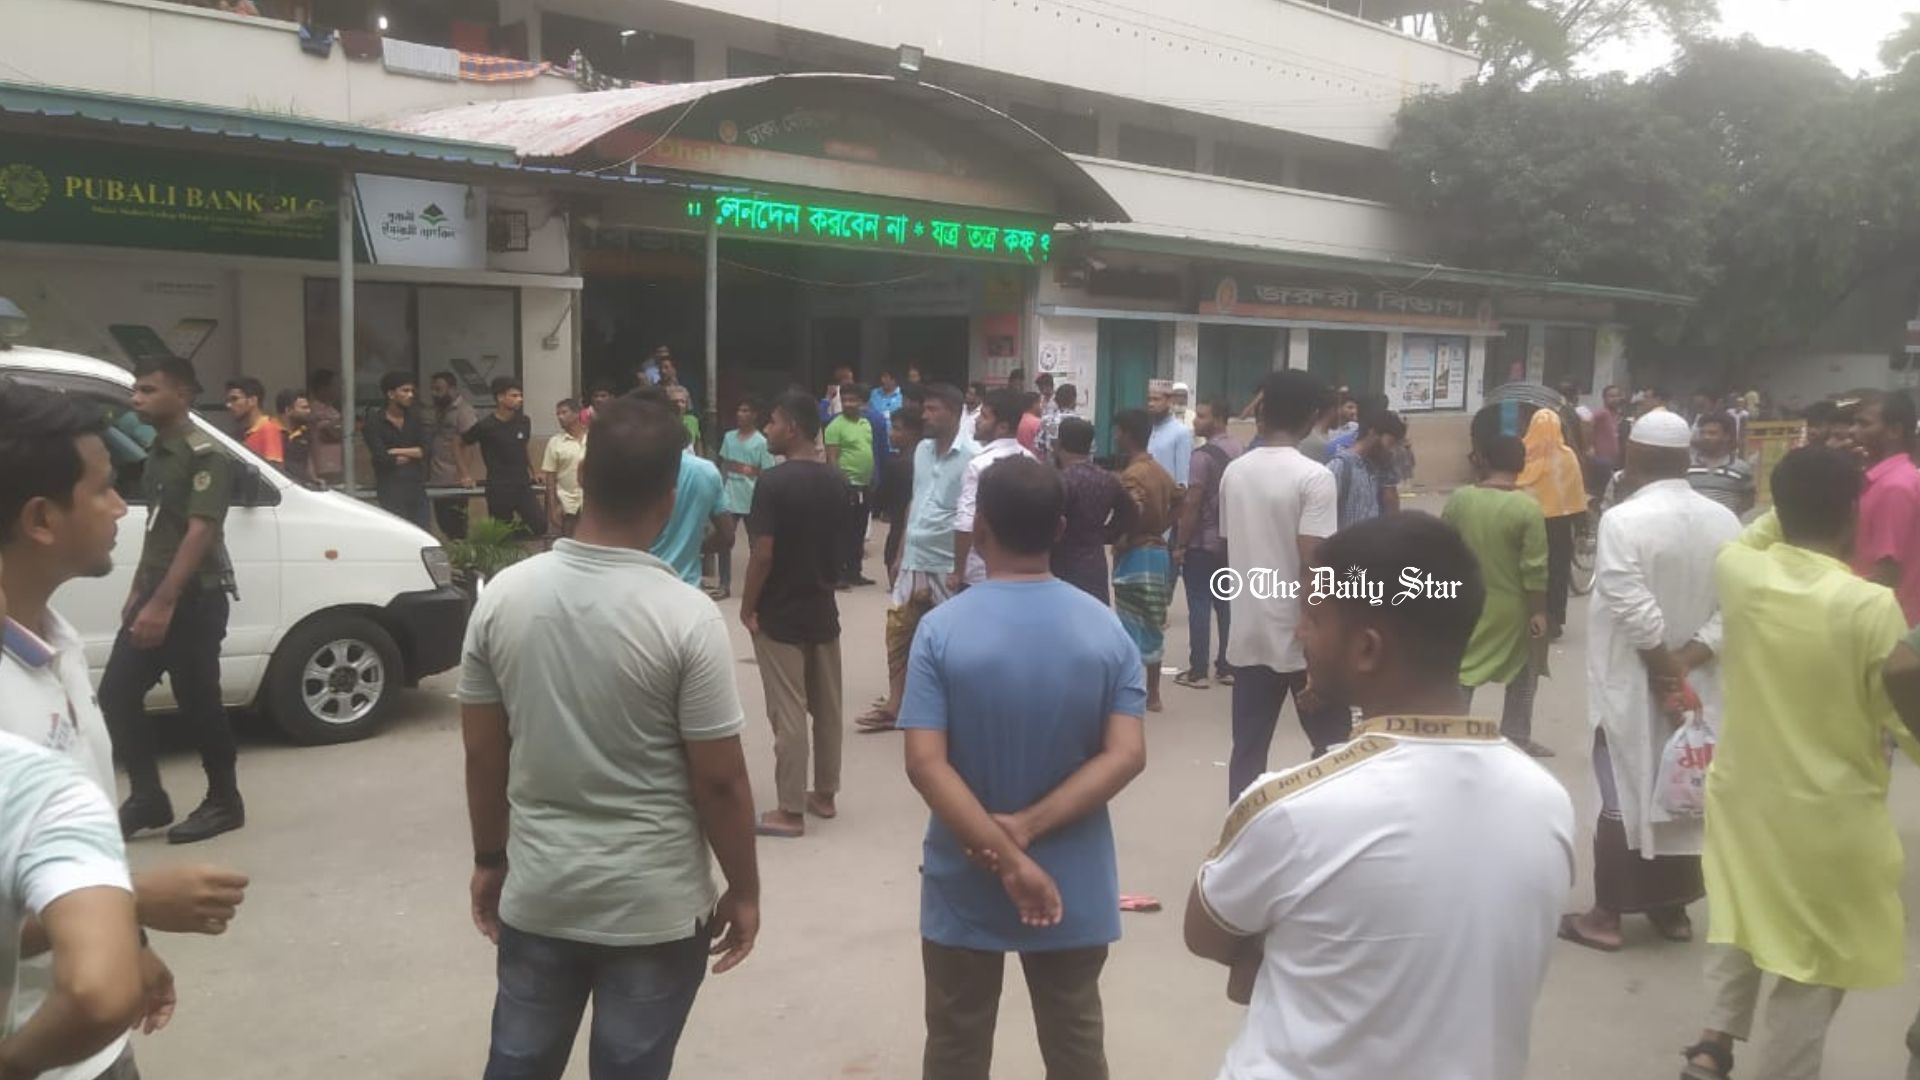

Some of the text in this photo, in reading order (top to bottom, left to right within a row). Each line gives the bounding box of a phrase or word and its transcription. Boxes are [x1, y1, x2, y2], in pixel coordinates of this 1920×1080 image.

[64, 175, 176, 207] PUBALI
[186, 186, 264, 213] BANK
[807, 206, 880, 241] করবেন
[885, 213, 909, 245] না
[931, 220, 962, 249] যত্র
[966, 224, 1000, 252] তত্র
[1376, 289, 1464, 317] বিভাগ
